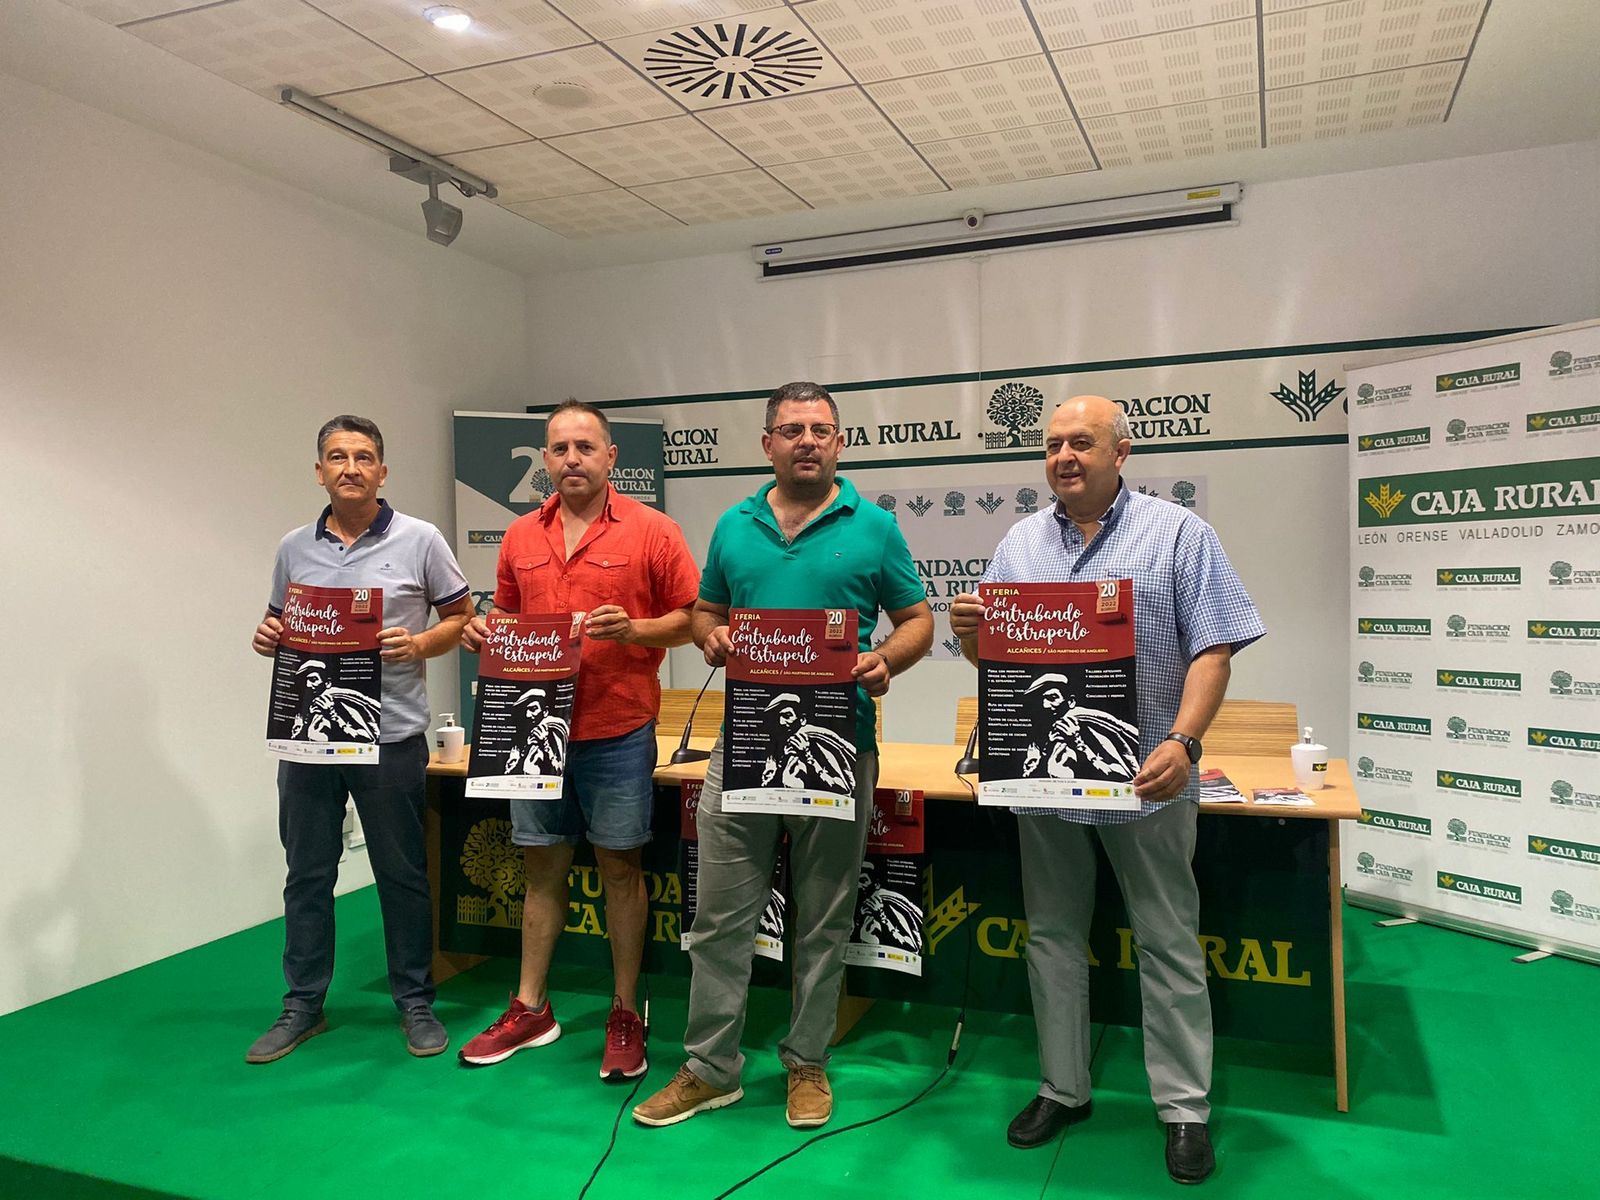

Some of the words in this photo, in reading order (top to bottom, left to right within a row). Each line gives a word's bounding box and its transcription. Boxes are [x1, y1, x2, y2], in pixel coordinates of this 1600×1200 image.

[1456, 375, 1480, 386] CAJA
[1482, 370, 1518, 382] RURAL
[1112, 394, 1211, 417] DACION
[1549, 416, 1577, 426] CAJA
[663, 428, 718, 446] ACION
[844, 427, 871, 448] JA
[878, 420, 960, 445] RURAL
[1374, 437, 1395, 447] CAJA
[1397, 434, 1428, 445] RURAL
[612, 480, 655, 492] RURAL
[1411, 489, 1486, 516] CAJA
[1358, 532, 1387, 544] LEÓN
[1397, 530, 1448, 543] ORENSE
[1459, 525, 1544, 540] VALLADOLID
[1482, 574, 1519, 582] RURAL
[355, 590, 368, 600] 20
[1101, 583, 1116, 597] 20
[993, 598, 1008, 607] del
[285, 601, 341, 620] Contrabando
[829, 612, 842, 624] 20
[984, 602, 1083, 622] Contrabando
[290, 616, 345, 637] Estraperlo
[496, 625, 507, 633] del
[739, 622, 750, 632] del
[990, 625, 994, 635] y
[997, 624, 1005, 633] el
[1007, 621, 1090, 644] Estraperlo
[1374, 624, 1395, 632] CAJA
[1549, 627, 1576, 636] CAJA
[487, 630, 562, 646] Contrabando
[732, 628, 814, 646] Contrabando
[496, 646, 503, 654] el
[504, 645, 564, 665] Estraperlo
[741, 645, 749, 654] el
[750, 645, 819, 667] Estraperlo
[1456, 677, 1480, 686] CAJA
[1483, 678, 1519, 688] RURAL
[1373, 720, 1395, 729] CAJA
[1397, 722, 1429, 732] RURAL
[1550, 736, 1578, 747] CAJA
[1456, 778, 1481, 790] CAJA
[1483, 782, 1520, 794] RURAL
[898, 791, 910, 803] 20
[1374, 816, 1396, 827] CAJA
[1398, 820, 1429, 832] RURAL
[1550, 845, 1577, 858] CAJA
[1456, 881, 1481, 894] CAJA
[1483, 886, 1520, 901] RURAL
